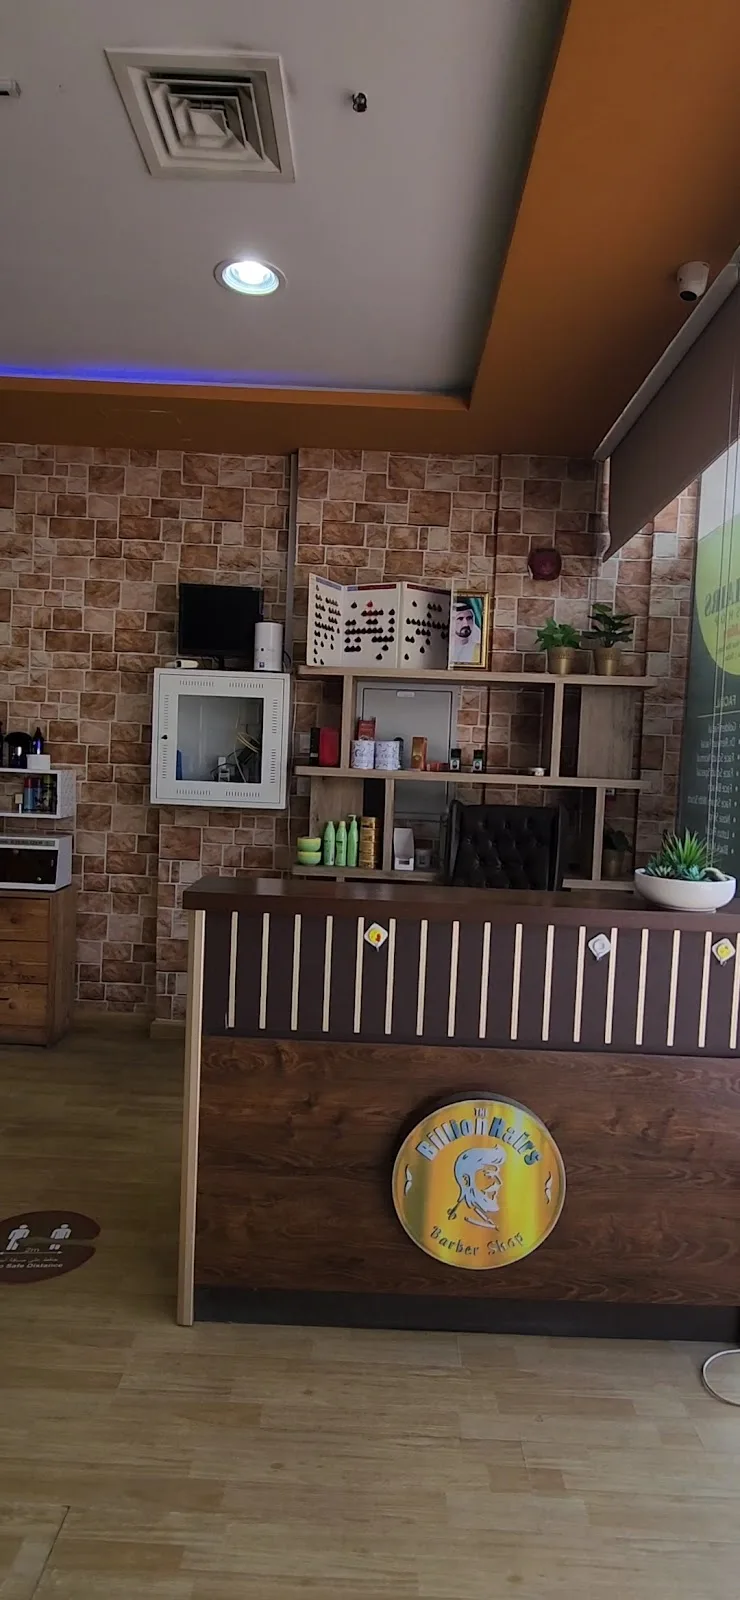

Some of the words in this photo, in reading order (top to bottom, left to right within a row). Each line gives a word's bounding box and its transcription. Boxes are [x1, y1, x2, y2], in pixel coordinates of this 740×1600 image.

[415, 1117, 485, 1161] Billion
[488, 1116, 543, 1166] Hairs
[430, 1225, 480, 1256] Barber
[487, 1232, 525, 1256] Shop
